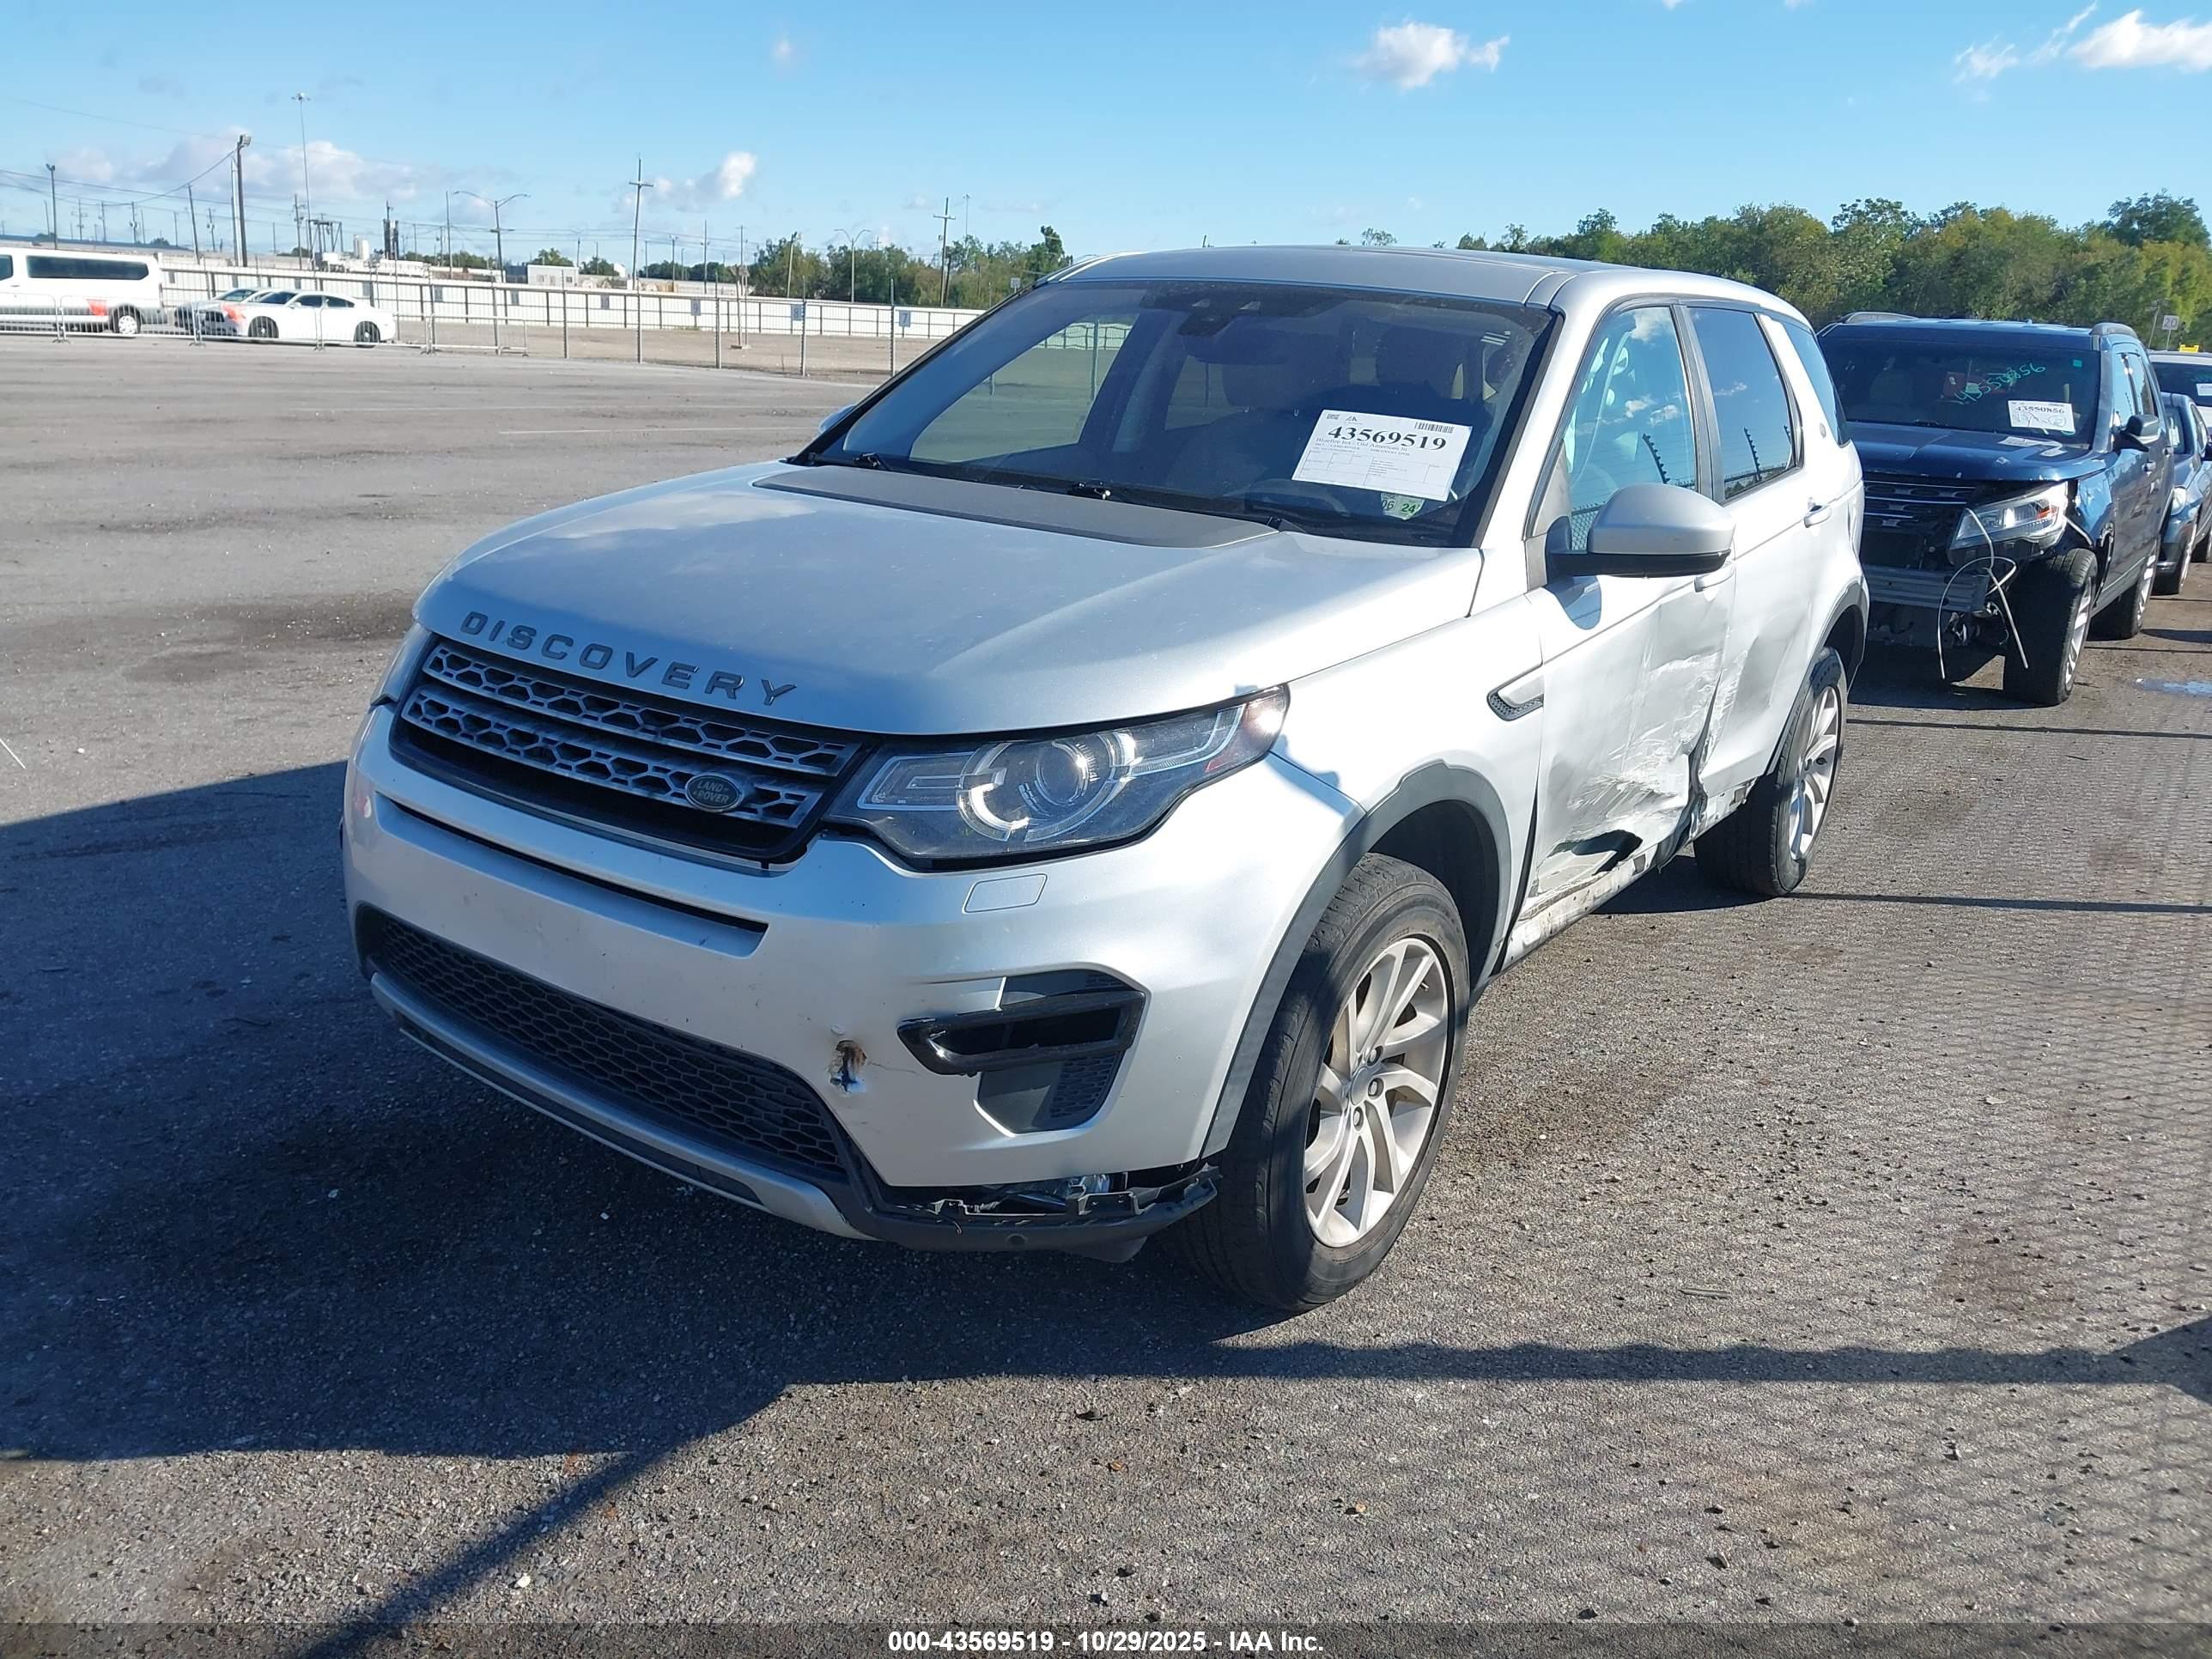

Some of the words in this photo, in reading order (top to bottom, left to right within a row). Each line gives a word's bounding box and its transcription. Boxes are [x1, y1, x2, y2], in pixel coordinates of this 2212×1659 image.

[2164, 318, 2178, 327] 20
[1328, 425, 1447, 451] 43569519
[1401, 503, 1415, 514] 24
[460, 611, 798, 706] DISCOVERY
[697, 789, 730, 804] ROVER
